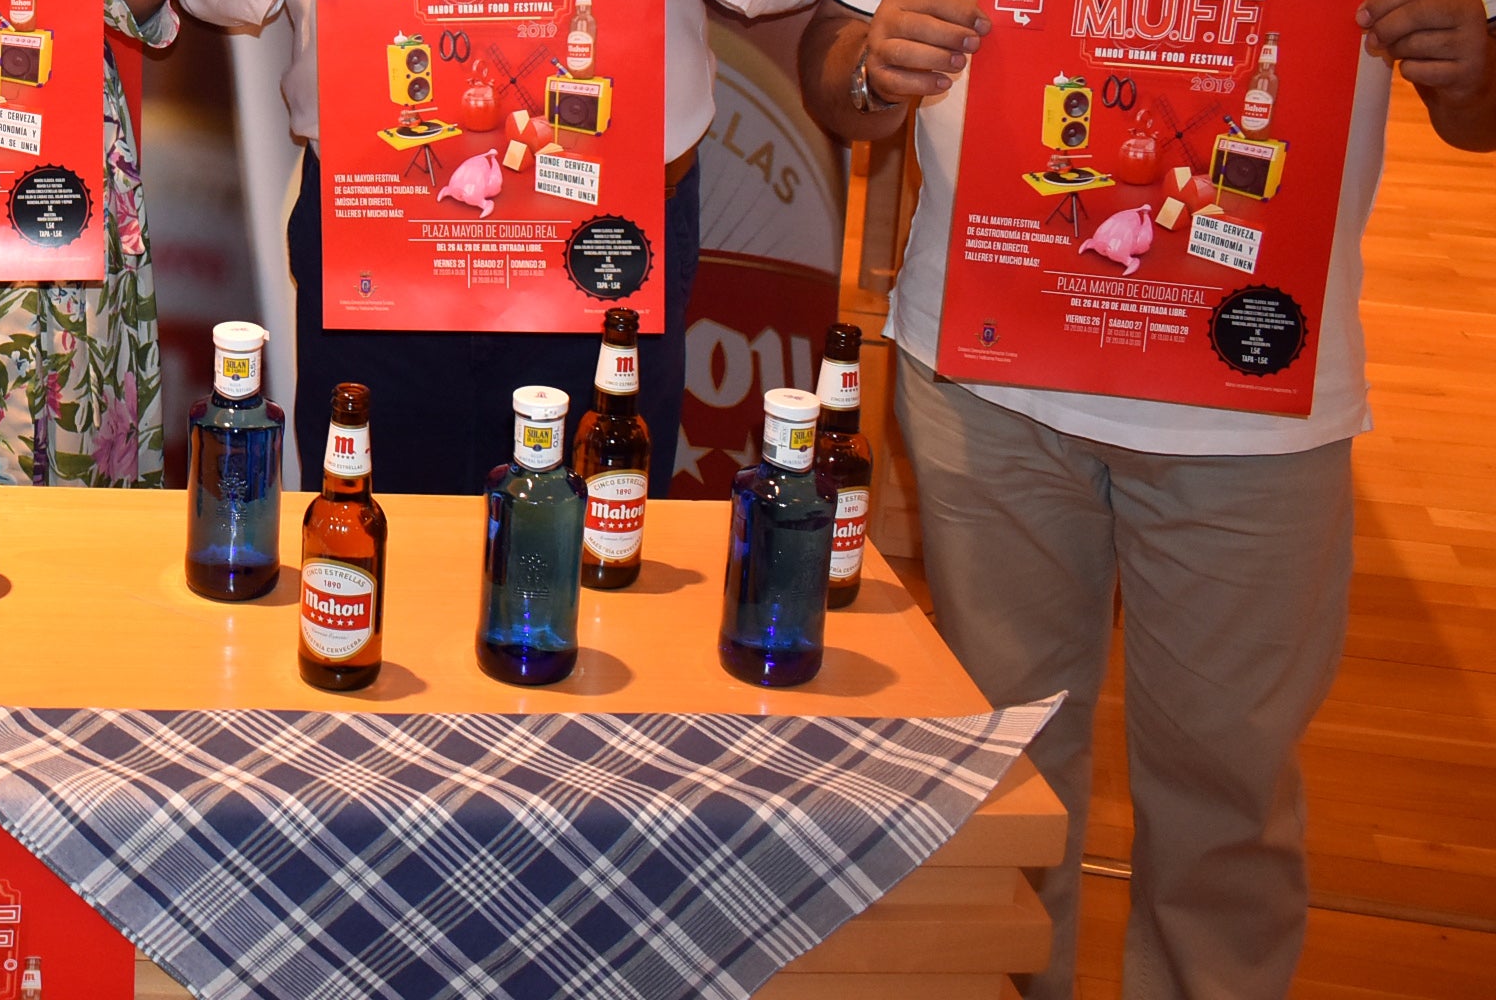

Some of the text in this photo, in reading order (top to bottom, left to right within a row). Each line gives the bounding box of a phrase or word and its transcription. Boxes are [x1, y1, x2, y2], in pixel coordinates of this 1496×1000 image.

[428, 2, 553, 14] MAHOU URBAN FOOD FESTIVAL
[517, 21, 557, 38] 2019
[1095, 48, 1233, 66] MAHOU URBAN FOOD FESTIVAL
[1190, 75, 1235, 94] 2019
[420, 222, 557, 238] PLAZA MAYOR DE CIUDAD REAL
[1196, 215, 1218, 230] DONDE
[1249, 246, 1253, 255] Y
[1220, 253, 1228, 263] SE
[1234, 258, 1252, 270] UNEN
[1057, 273, 1204, 304] PLAZA MAYOR DE CIUDAD REAL
[594, 480, 615, 490] CINCO
[591, 501, 644, 519] Mahou
[833, 522, 864, 537] aho
[306, 568, 365, 588] CINCO ESTRELLAS
[324, 580, 341, 589] 1890
[305, 588, 364, 617] Mahou
[326, 638, 362, 653] CERVECERA
